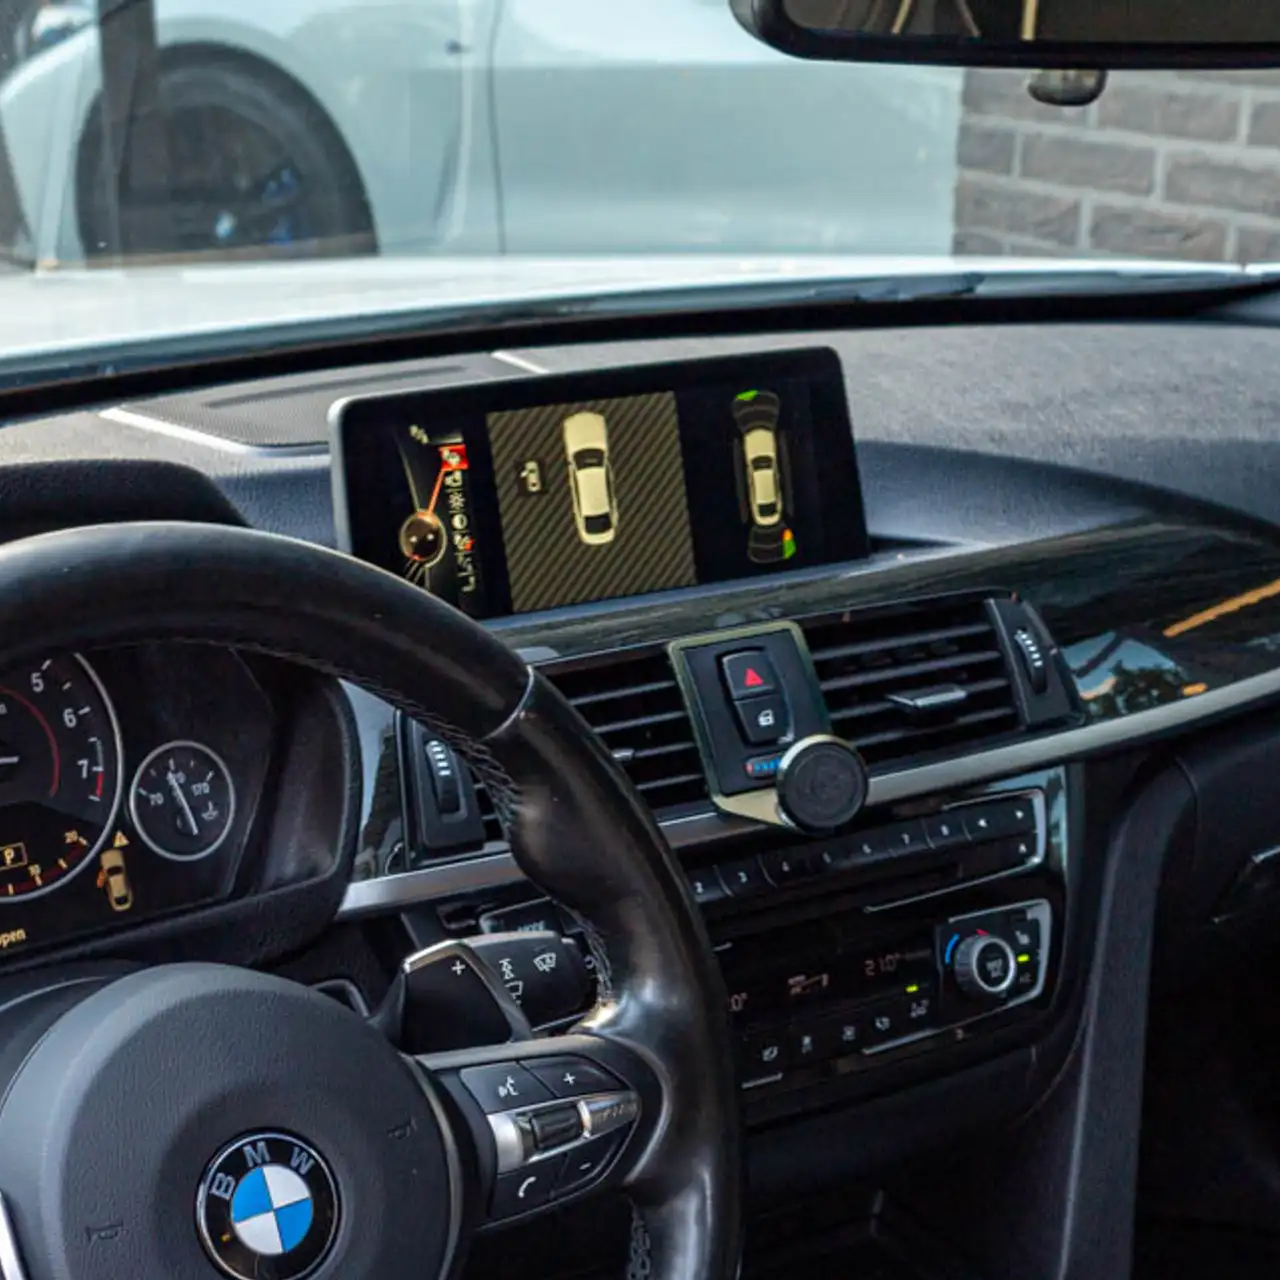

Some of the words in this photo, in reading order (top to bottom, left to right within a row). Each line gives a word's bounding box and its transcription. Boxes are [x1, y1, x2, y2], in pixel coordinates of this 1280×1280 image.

[30, 672, 44, 692] 5
[62, 707, 77, 728] 6
[77, 759, 89, 779] 7
[210, 1141, 316, 1201] BMW
